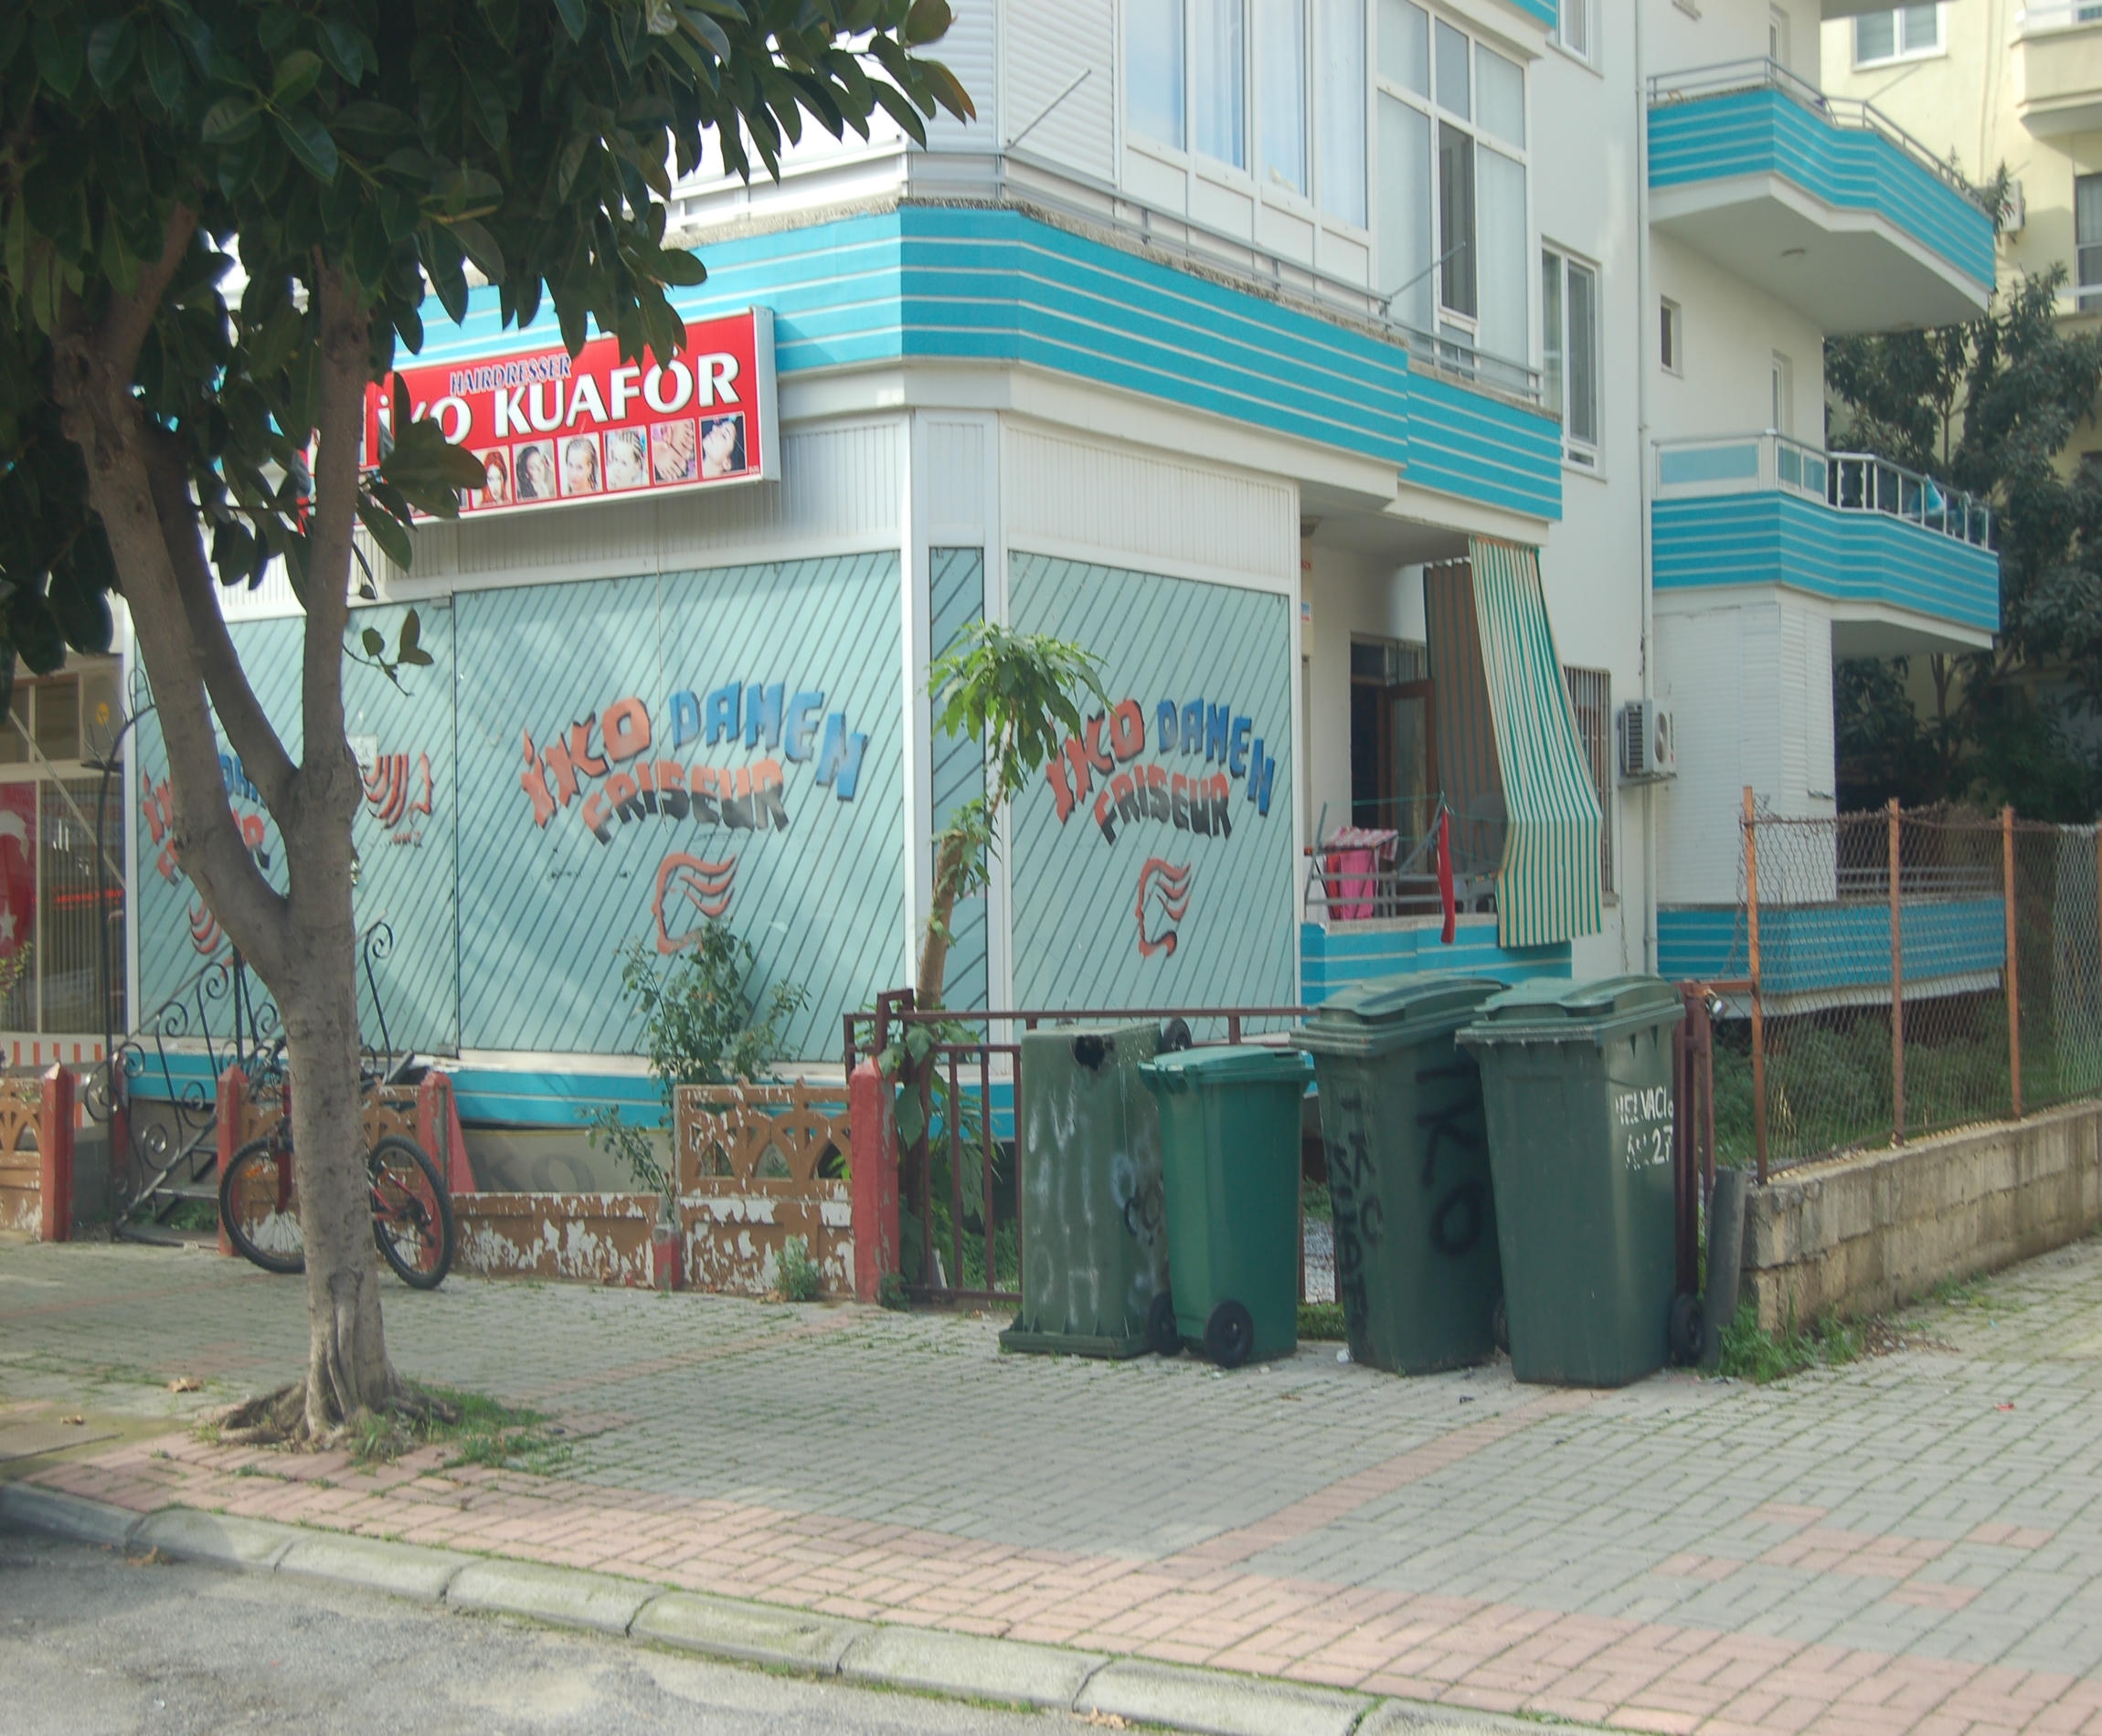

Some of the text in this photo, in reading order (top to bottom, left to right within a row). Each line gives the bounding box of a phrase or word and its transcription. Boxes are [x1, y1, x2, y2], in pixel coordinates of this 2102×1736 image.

[450, 353, 572, 396] HAIRDRESSER
[669, 681, 867, 802] DAMEN
[1157, 695, 1276, 819] DAMEN
[581, 757, 790, 847] FRISEUR
[1094, 765, 1232, 846] FRISEUR
